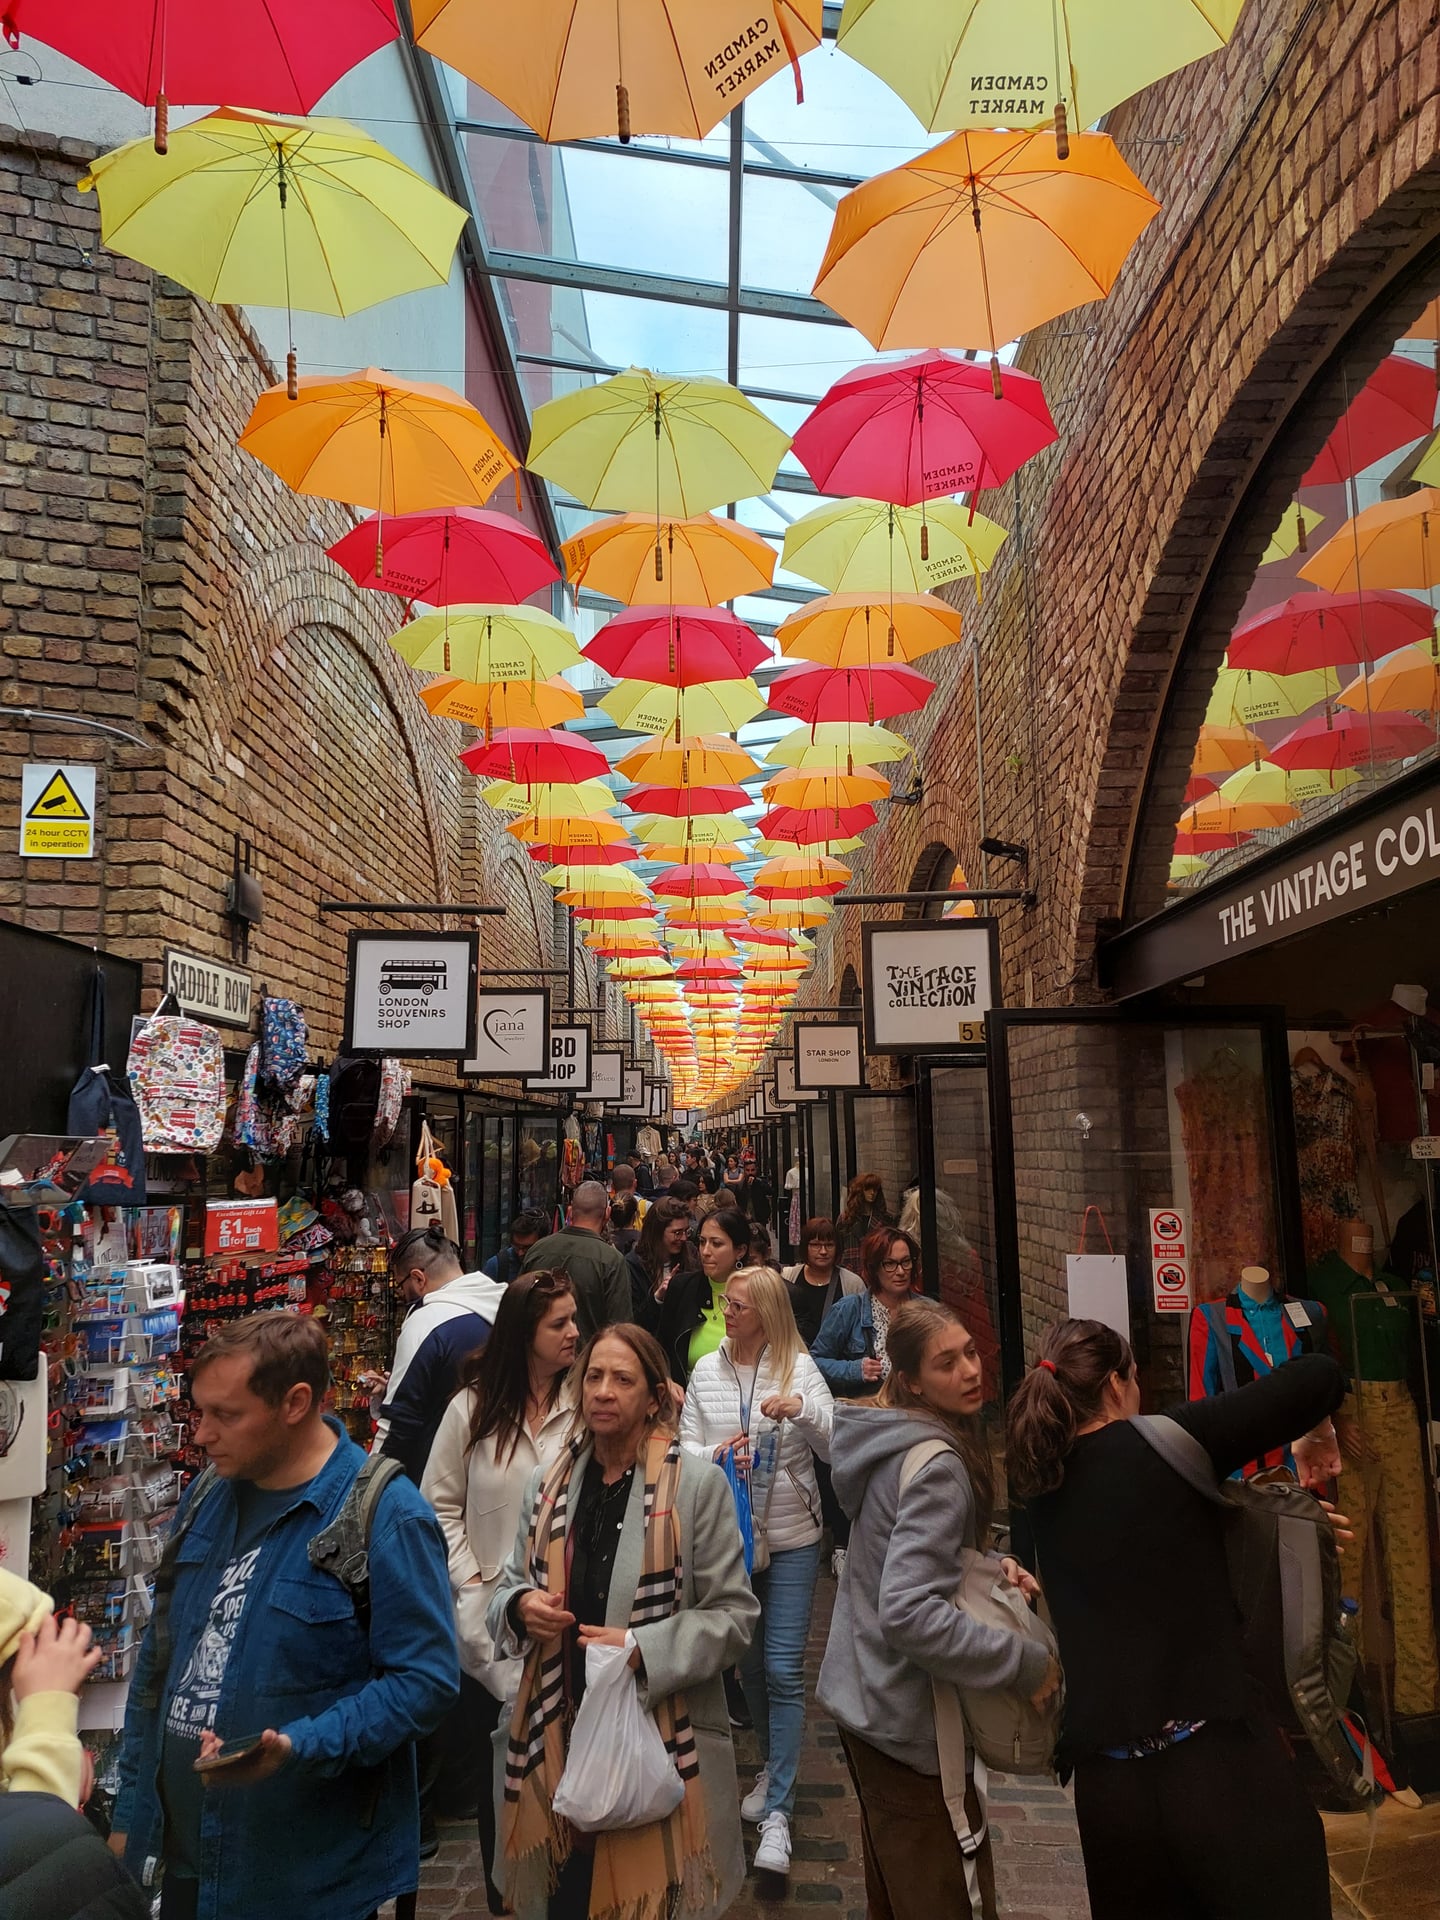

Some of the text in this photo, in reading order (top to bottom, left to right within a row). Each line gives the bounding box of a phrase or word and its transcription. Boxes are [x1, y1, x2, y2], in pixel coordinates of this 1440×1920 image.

[1243, 701, 1279, 712] CAMDEN
[1245, 708, 1280, 719] MARKET
[1294, 783, 1321, 793] CAMDEN
[1296, 789, 1323, 798] MARKET
[63, 829, 89, 837] CCTV
[41, 840, 84, 848] operation
[1218, 807, 1440, 945] THE VINTAGE COL
[886, 965, 921, 980] THE
[170, 960, 250, 1015] SADDLE ROW
[379, 998, 429, 1007] LONDON
[378, 1009, 446, 1018] SOUVENIRS
[378, 1020, 410, 1028] SHOP
[494, 1019, 524, 1035] jana
[552, 1037, 576, 1057] BD
[550, 1064, 576, 1079] HOP
[220, 1218, 242, 1235] £1
[230, 1237, 245, 1245] for
